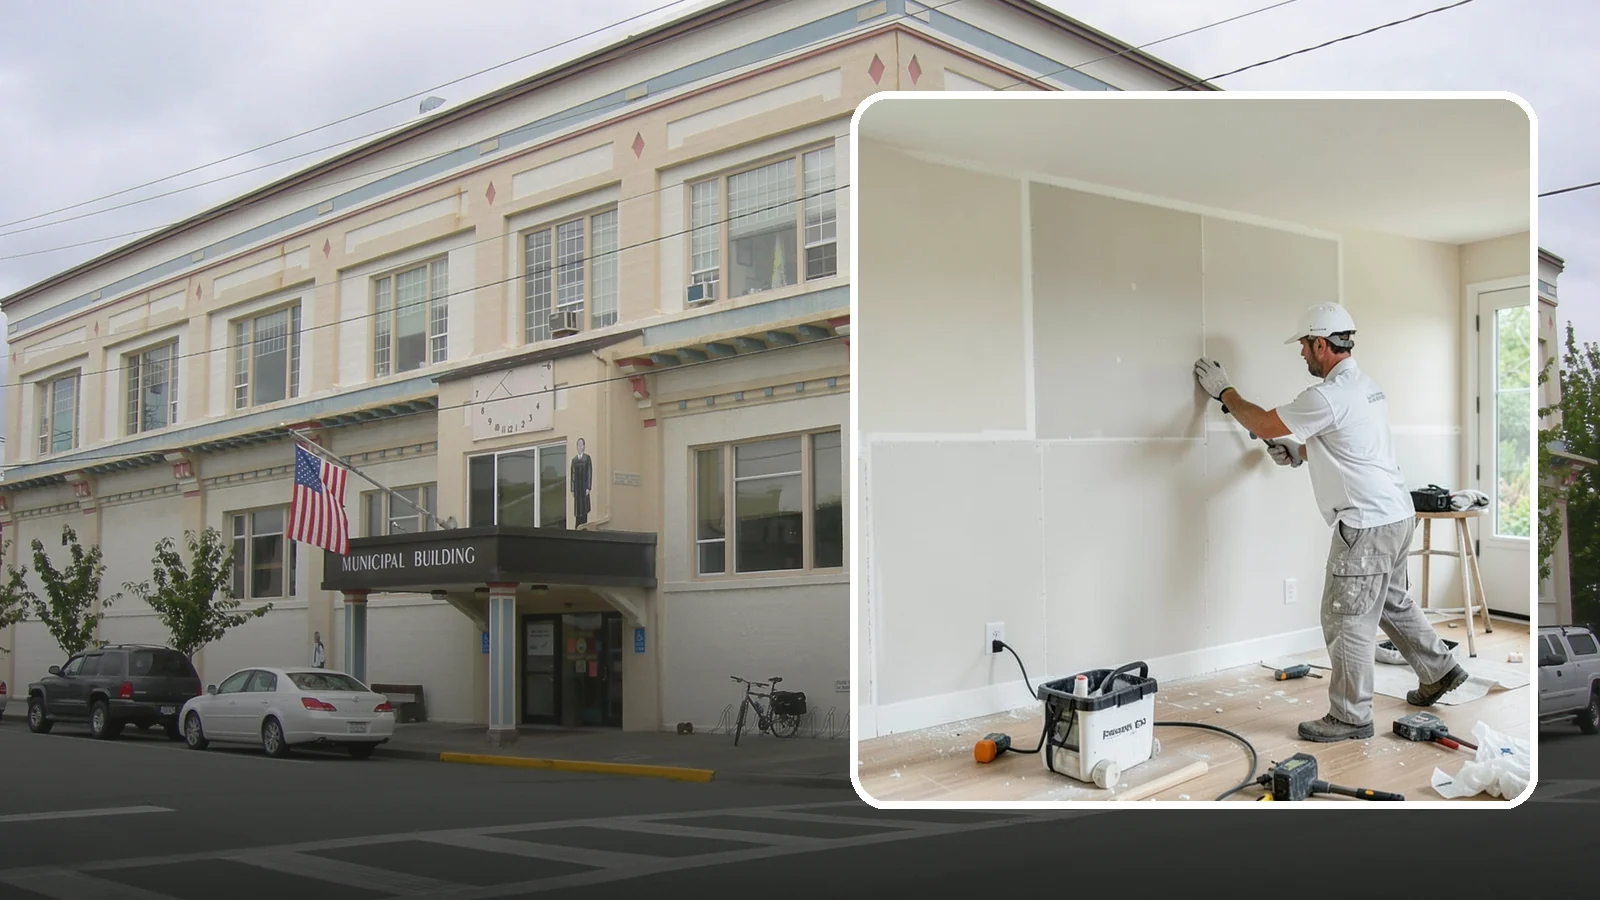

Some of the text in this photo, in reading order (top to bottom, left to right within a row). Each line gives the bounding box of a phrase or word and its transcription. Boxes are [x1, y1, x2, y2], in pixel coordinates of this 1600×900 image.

[536, 402, 540, 410] 4
[480, 407, 485, 415] 8
[487, 417, 492, 426] 9
[528, 414, 533, 422] 3
[494, 423, 500, 432] 10
[521, 420, 526, 428] 2
[501, 425, 506, 433] 11
[507, 425, 513, 433] 12
[341, 546, 475, 572] MUNICIPAL BUILDING
